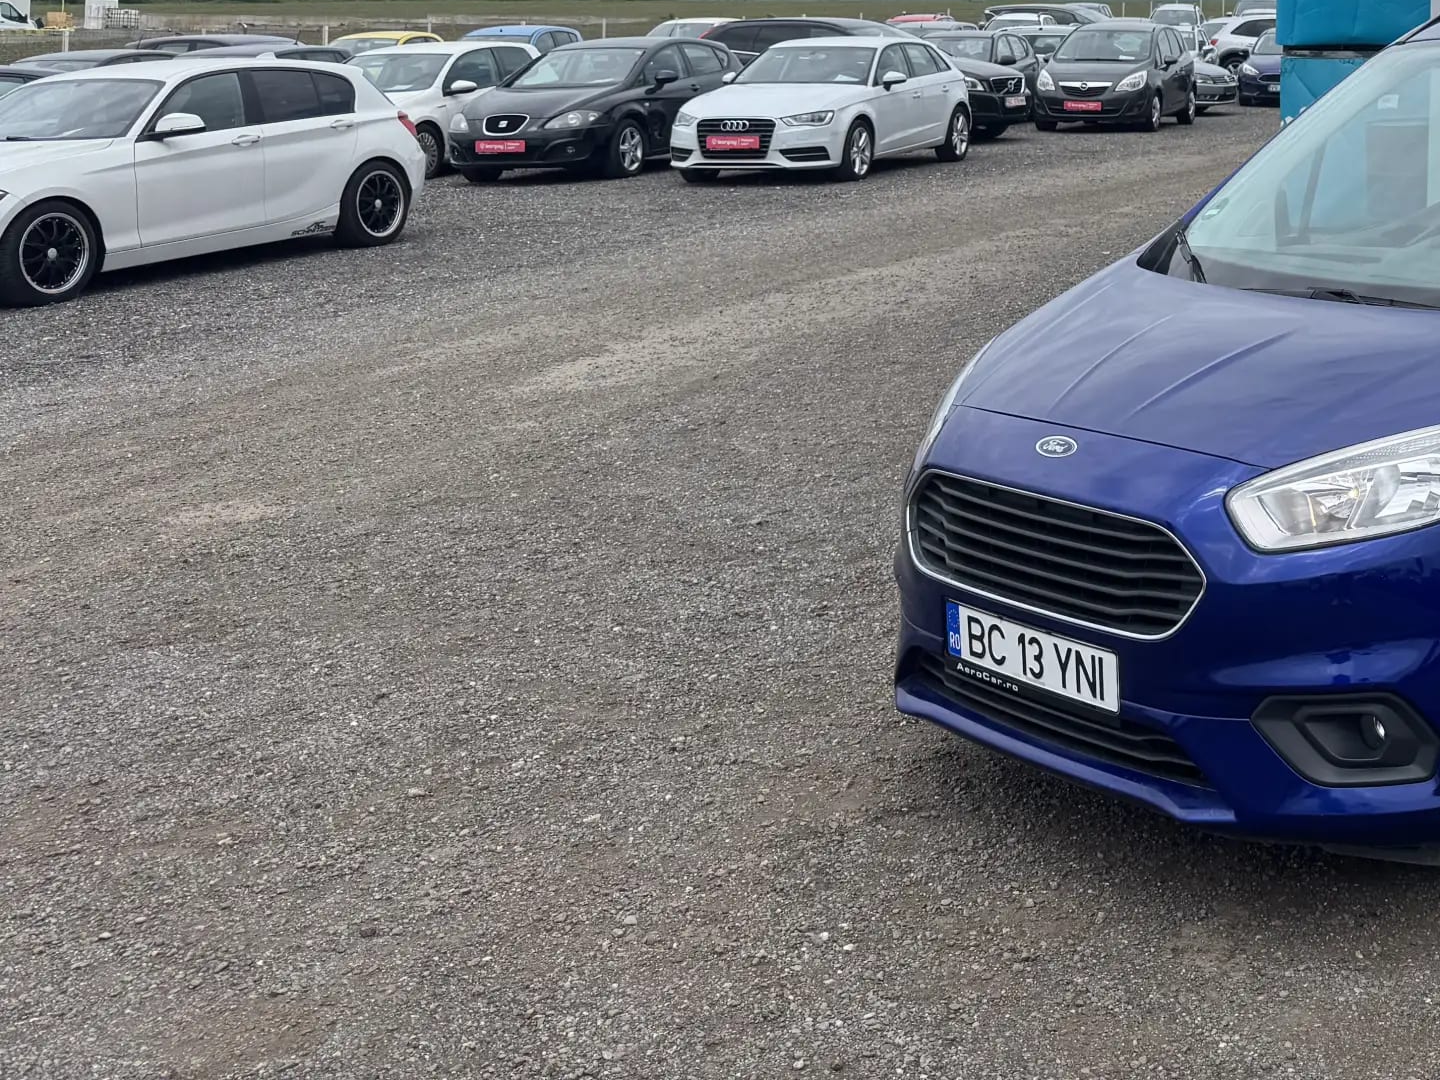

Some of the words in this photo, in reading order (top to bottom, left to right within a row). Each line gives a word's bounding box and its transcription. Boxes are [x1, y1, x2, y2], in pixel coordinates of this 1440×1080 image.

[949, 631, 961, 650] RO
[967, 615, 1007, 666] BC
[1018, 632, 1044, 679] 13
[1053, 642, 1105, 701] YNI
[956, 662, 1019, 692] AeroCar.ro
